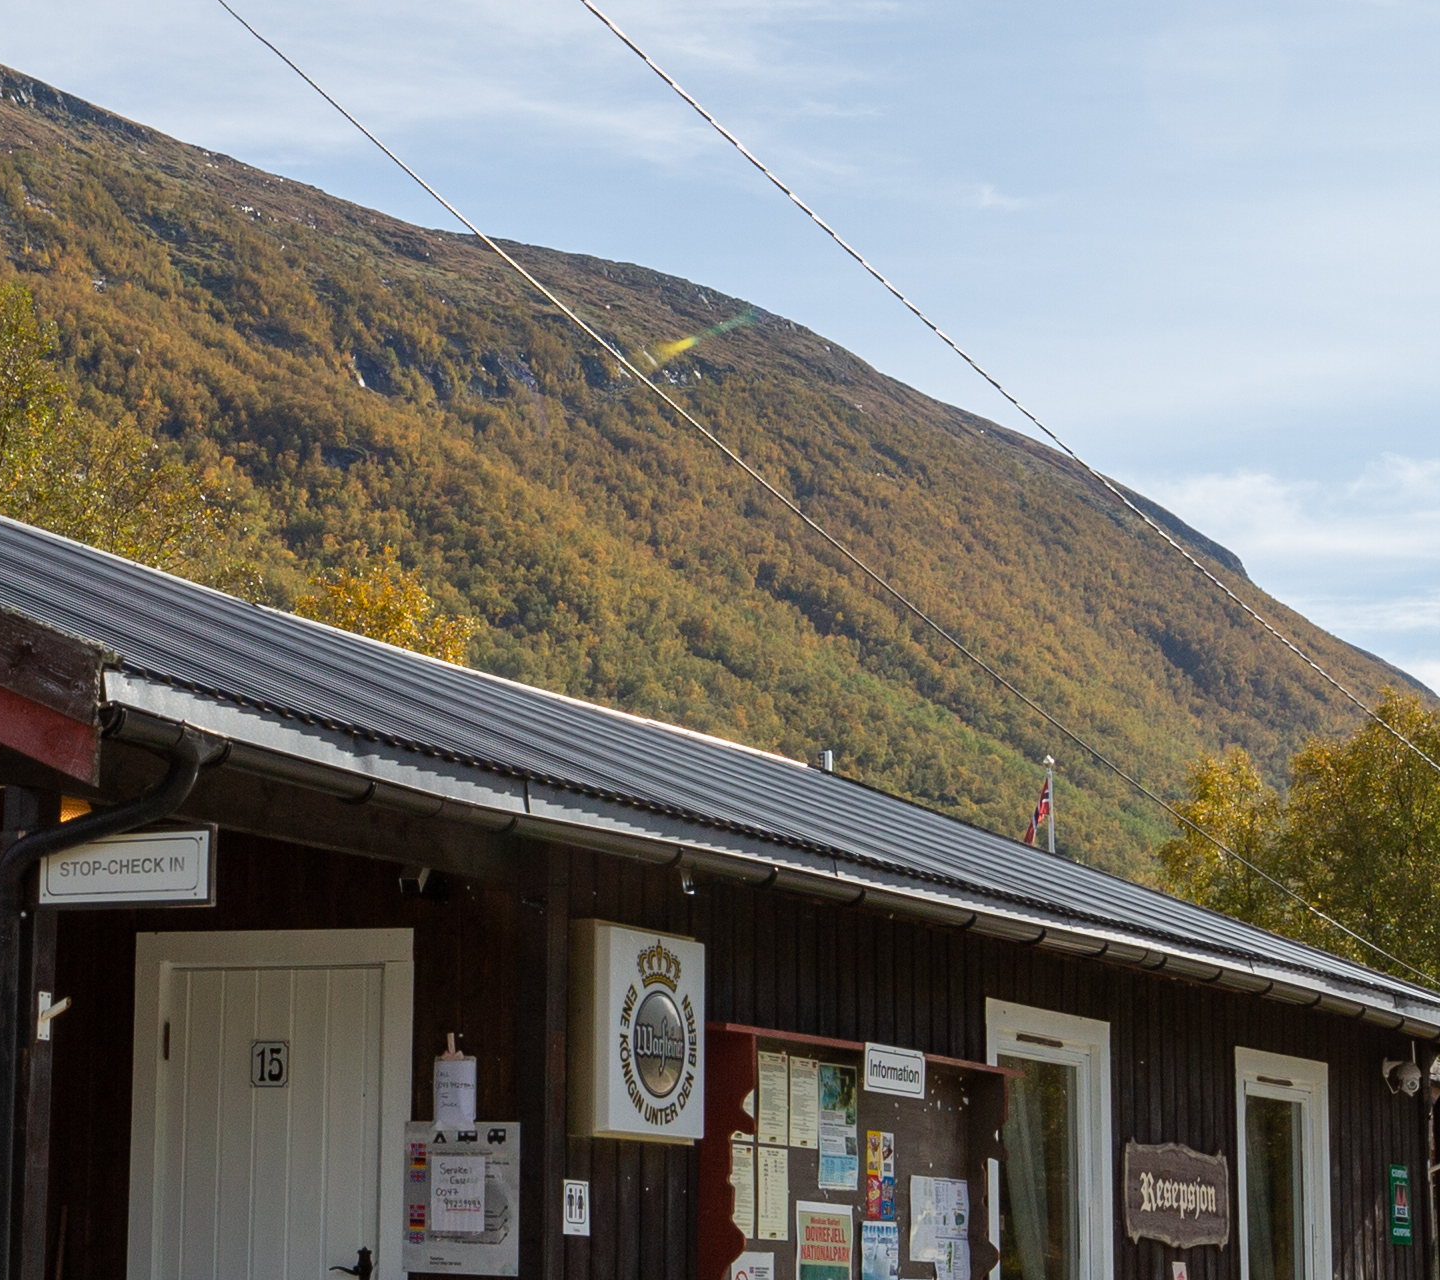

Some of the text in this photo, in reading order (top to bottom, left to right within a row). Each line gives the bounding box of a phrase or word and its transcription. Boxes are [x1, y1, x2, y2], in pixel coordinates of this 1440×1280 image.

[60, 856, 185, 877] STOP-CHECK IN
[256, 1047, 283, 1082] 15
[619, 983, 697, 1126] EINE KÖNIGIN UNTER DEN BIEREN
[869, 1058, 920, 1084] Information
[440, 1162, 468, 1175] Service
[1139, 1171, 1217, 1220] Resepsjon
